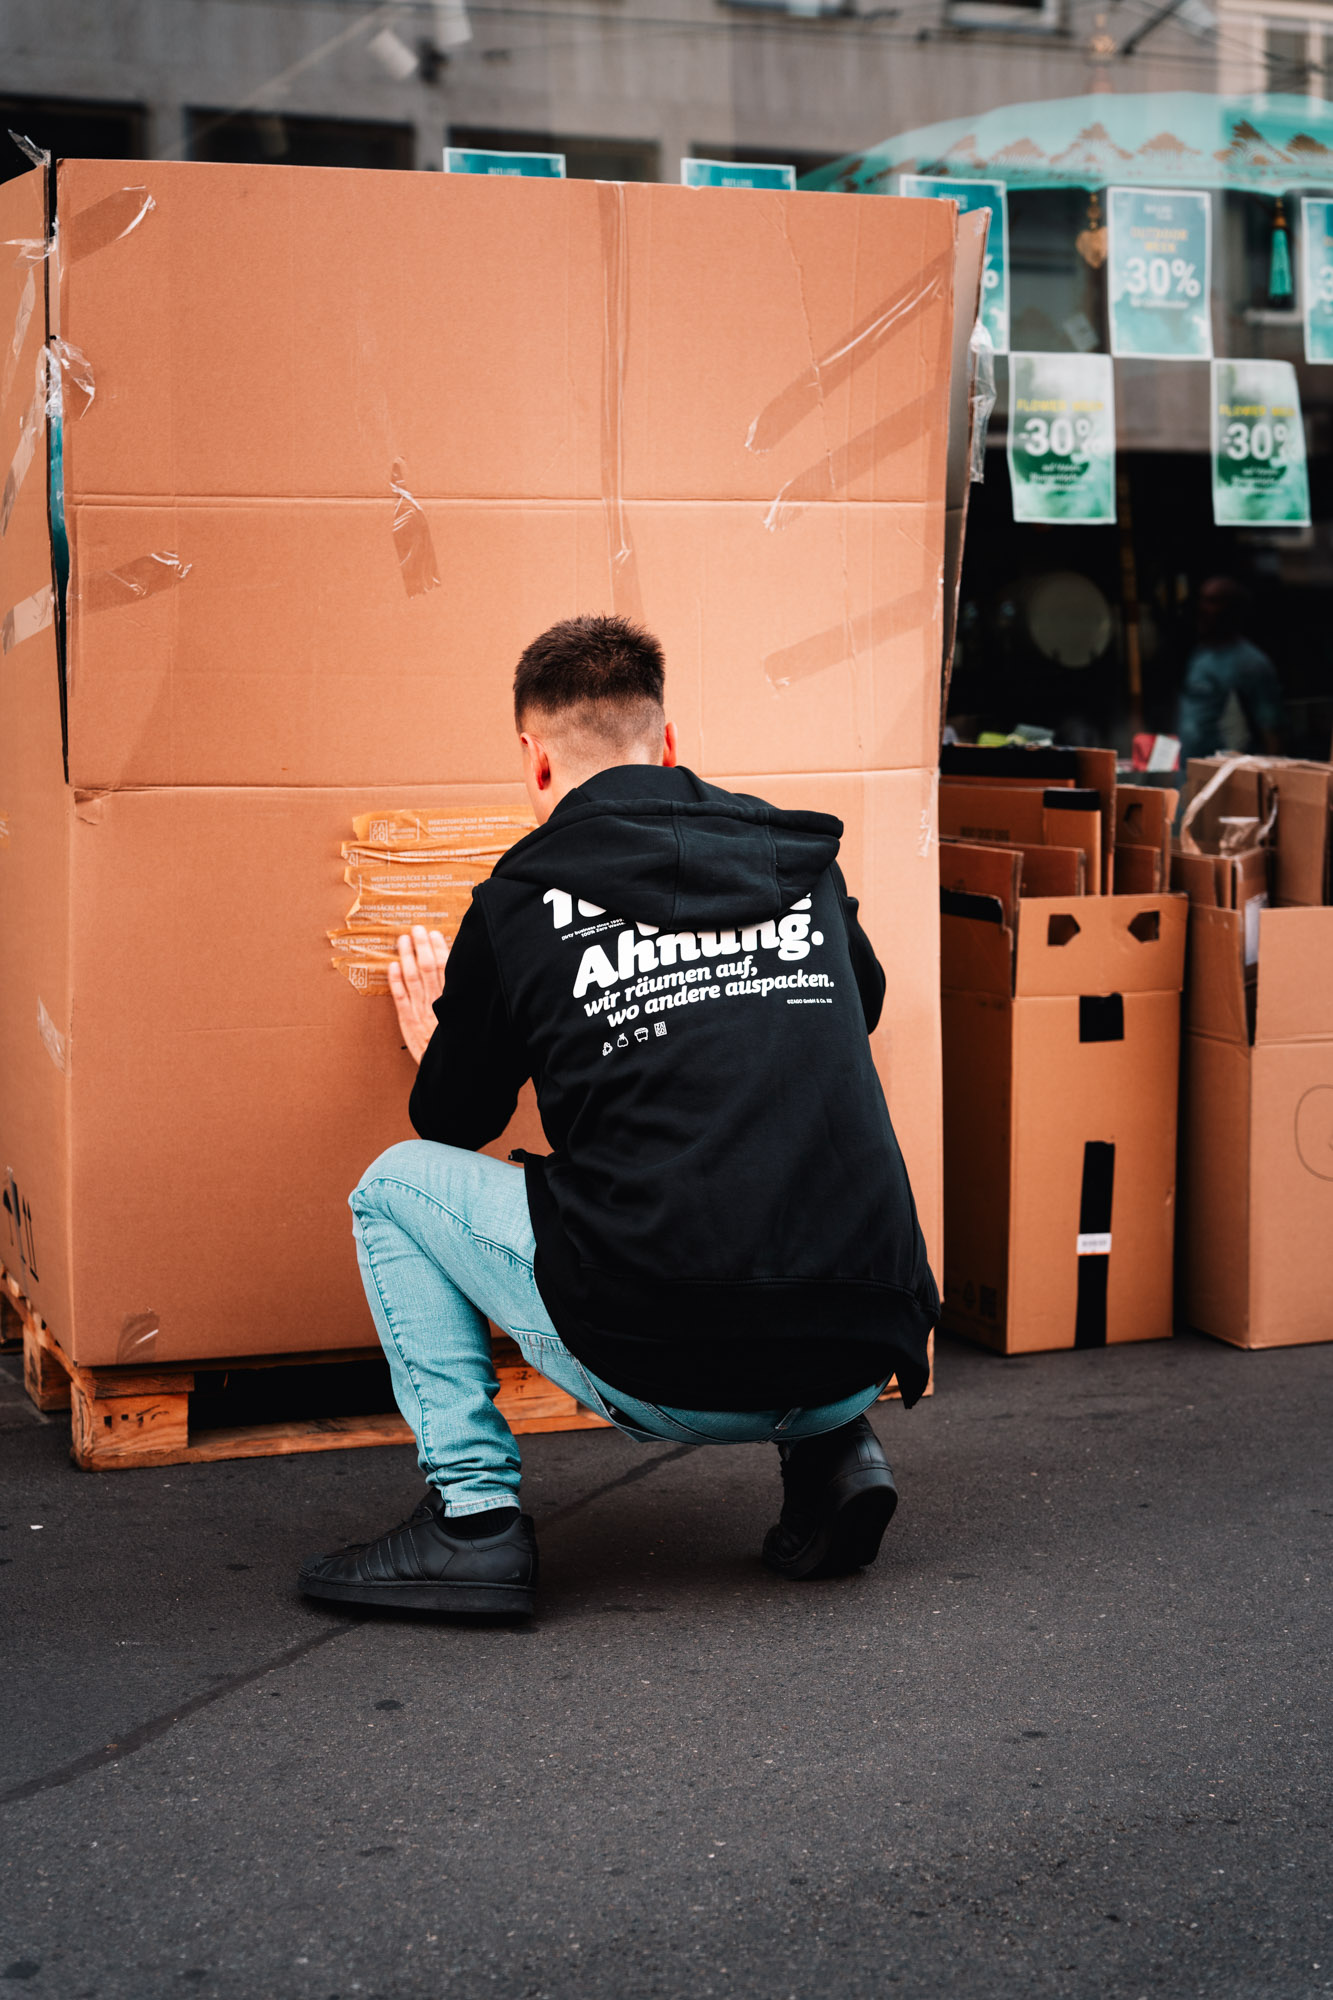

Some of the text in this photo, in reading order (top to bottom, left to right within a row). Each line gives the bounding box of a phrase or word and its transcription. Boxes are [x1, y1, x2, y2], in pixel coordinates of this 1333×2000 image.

[561, 932, 575, 941] Dirty
[574, 925, 596, 935] business
[596, 921, 610, 929] since
[573, 913, 824, 999] Ahnung.
[583, 954, 758, 1017] wir räumen auf,
[606, 968, 835, 1028] wo andere auspacken.
